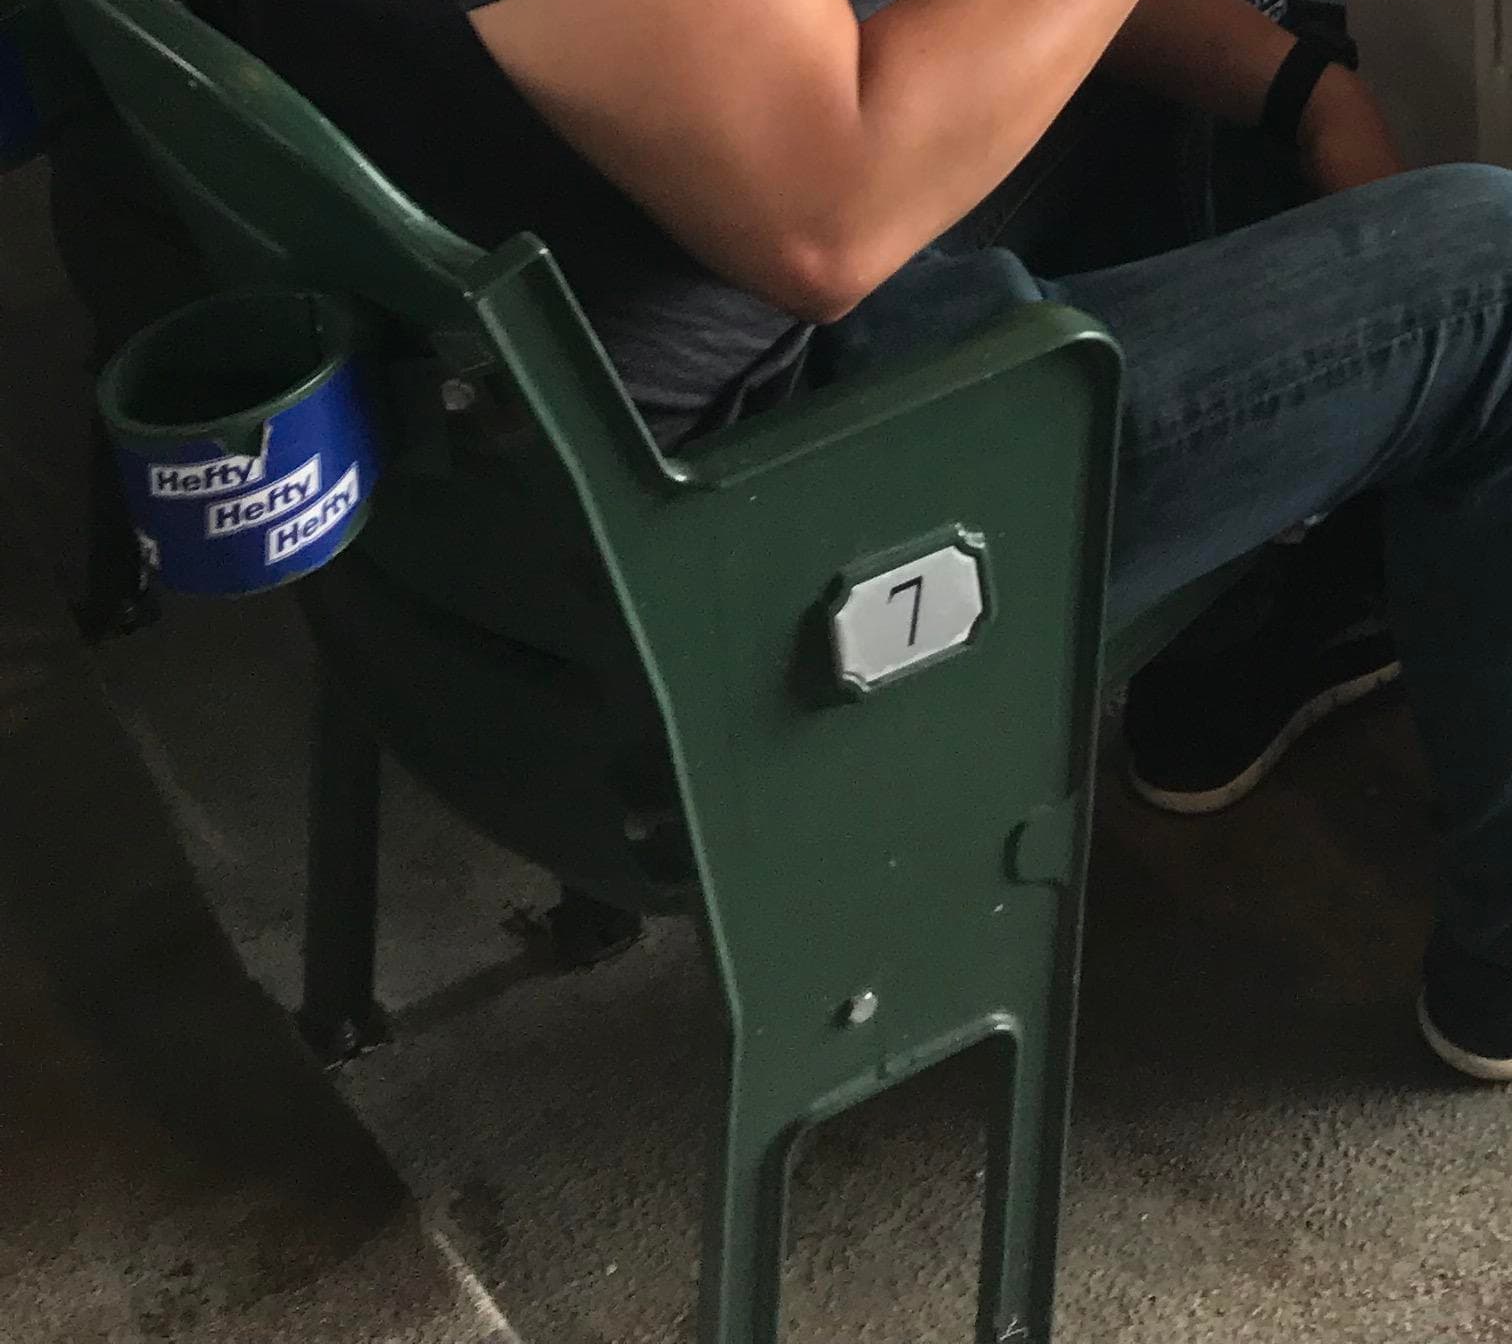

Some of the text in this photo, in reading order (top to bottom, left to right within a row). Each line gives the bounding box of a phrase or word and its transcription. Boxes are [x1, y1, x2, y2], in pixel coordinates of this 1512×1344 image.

[157, 459, 256, 492] Hefty
[214, 474, 312, 529] Hefty
[276, 489, 352, 553] Hefty
[886, 575, 923, 647] 7
